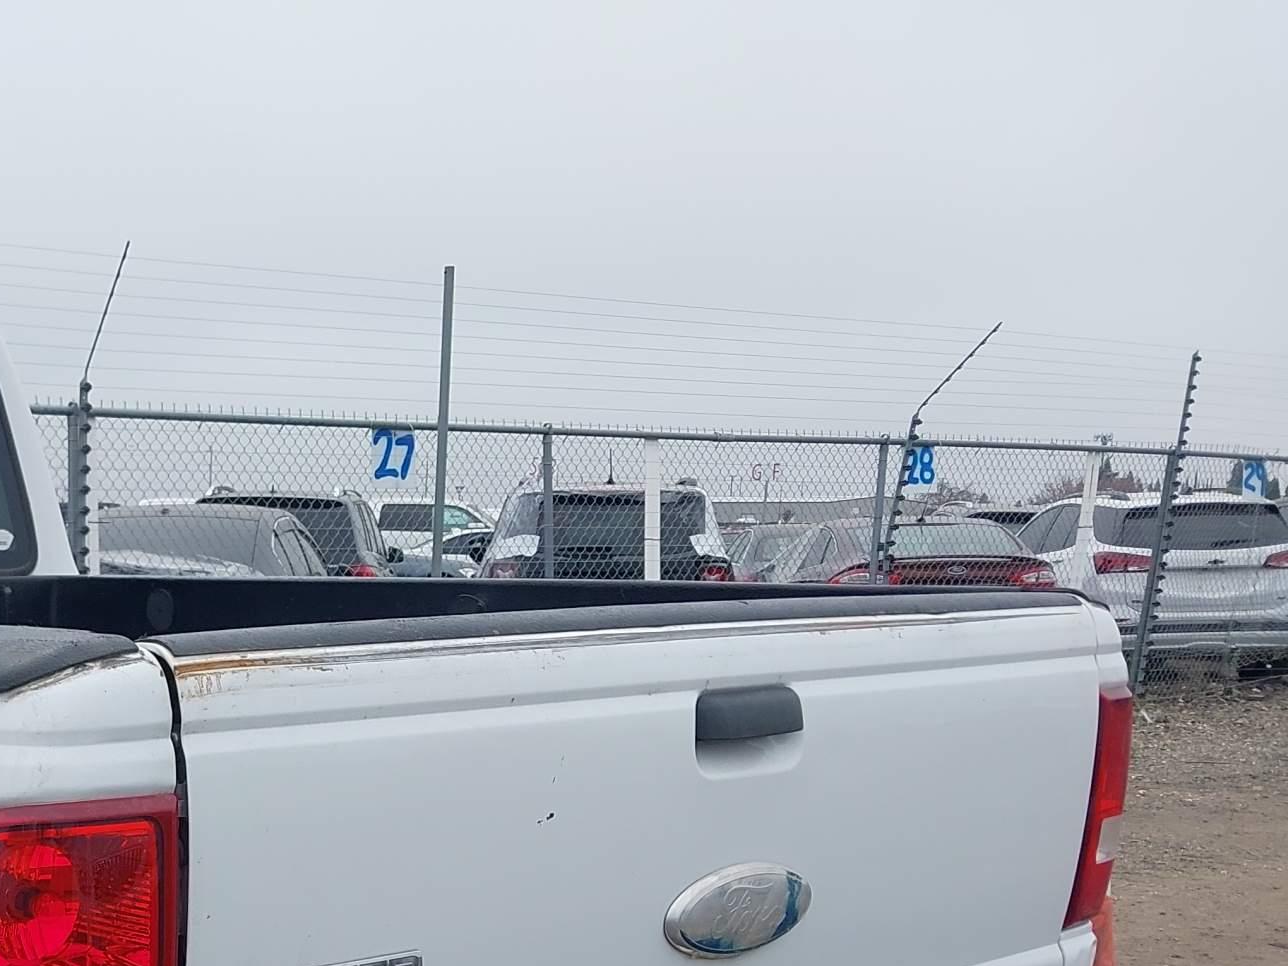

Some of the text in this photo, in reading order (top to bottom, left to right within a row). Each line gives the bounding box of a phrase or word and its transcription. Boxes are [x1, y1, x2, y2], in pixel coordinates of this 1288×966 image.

[373, 428, 415, 480] 27
[752, 463, 781, 481] G F
[905, 446, 935, 484] 28
[1244, 461, 1267, 496] 29
